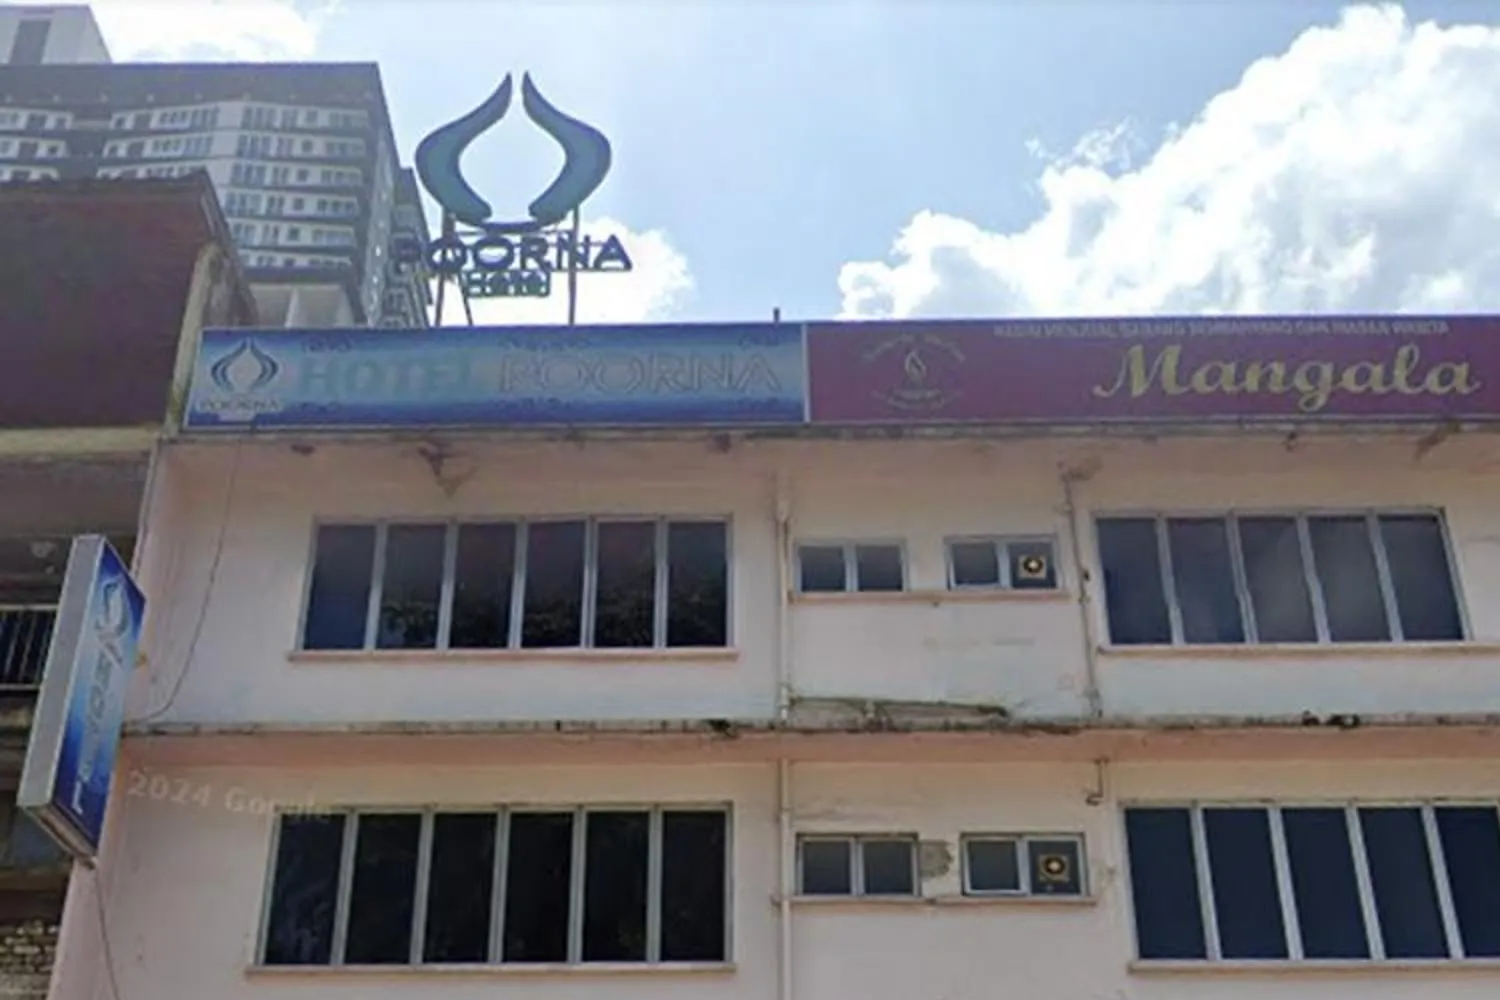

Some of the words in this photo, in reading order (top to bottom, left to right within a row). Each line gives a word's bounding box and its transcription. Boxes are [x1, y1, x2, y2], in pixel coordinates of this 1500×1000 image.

[396, 233, 633, 272] POORNA
[300, 355, 472, 397] HOTEL
[499, 350, 783, 394] POORNA
[1092, 344, 1481, 411] Mangala
